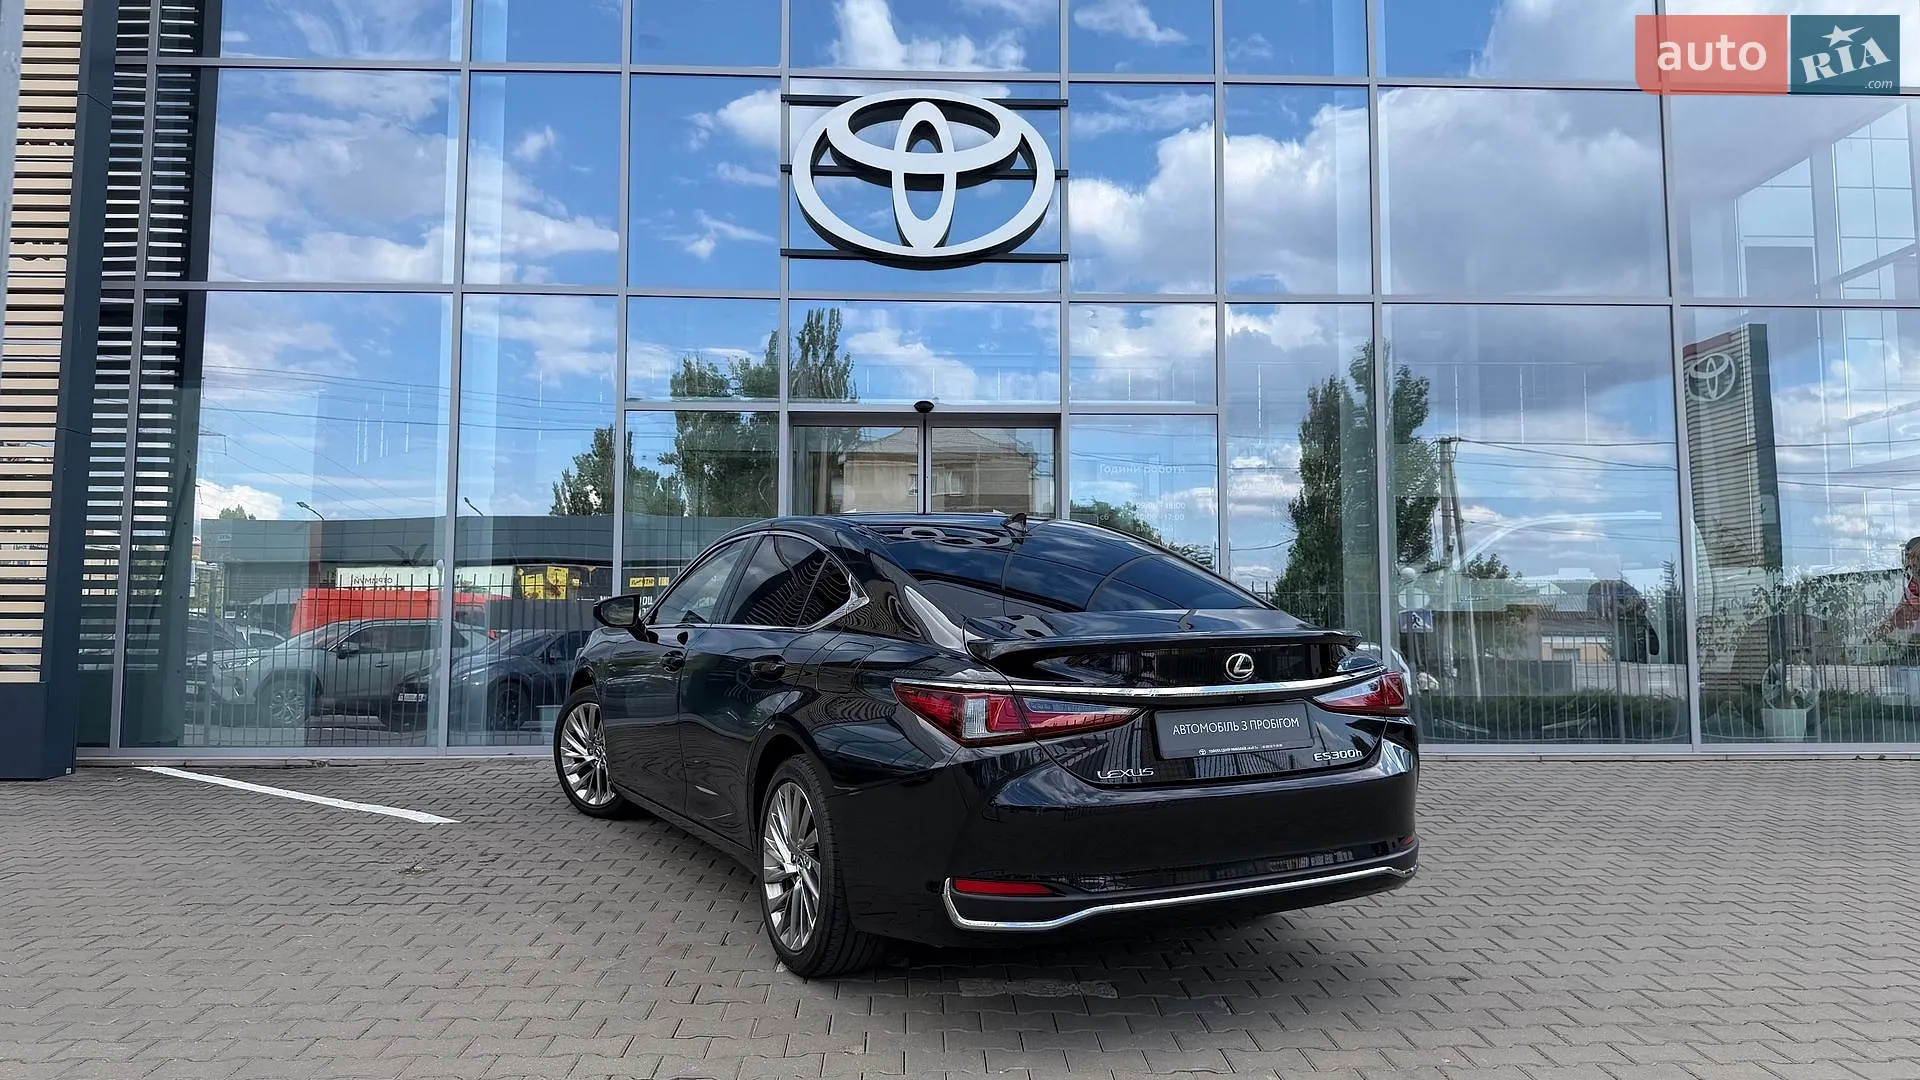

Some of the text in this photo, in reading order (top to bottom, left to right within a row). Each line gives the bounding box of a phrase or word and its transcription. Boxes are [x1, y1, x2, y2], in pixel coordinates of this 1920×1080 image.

[1172, 717, 1300, 736] АВТОМОБІЛЬ З ПРОБІГОМ
[1313, 748, 1363, 761] ES300h
[1097, 767, 1154, 779] LEXUS
